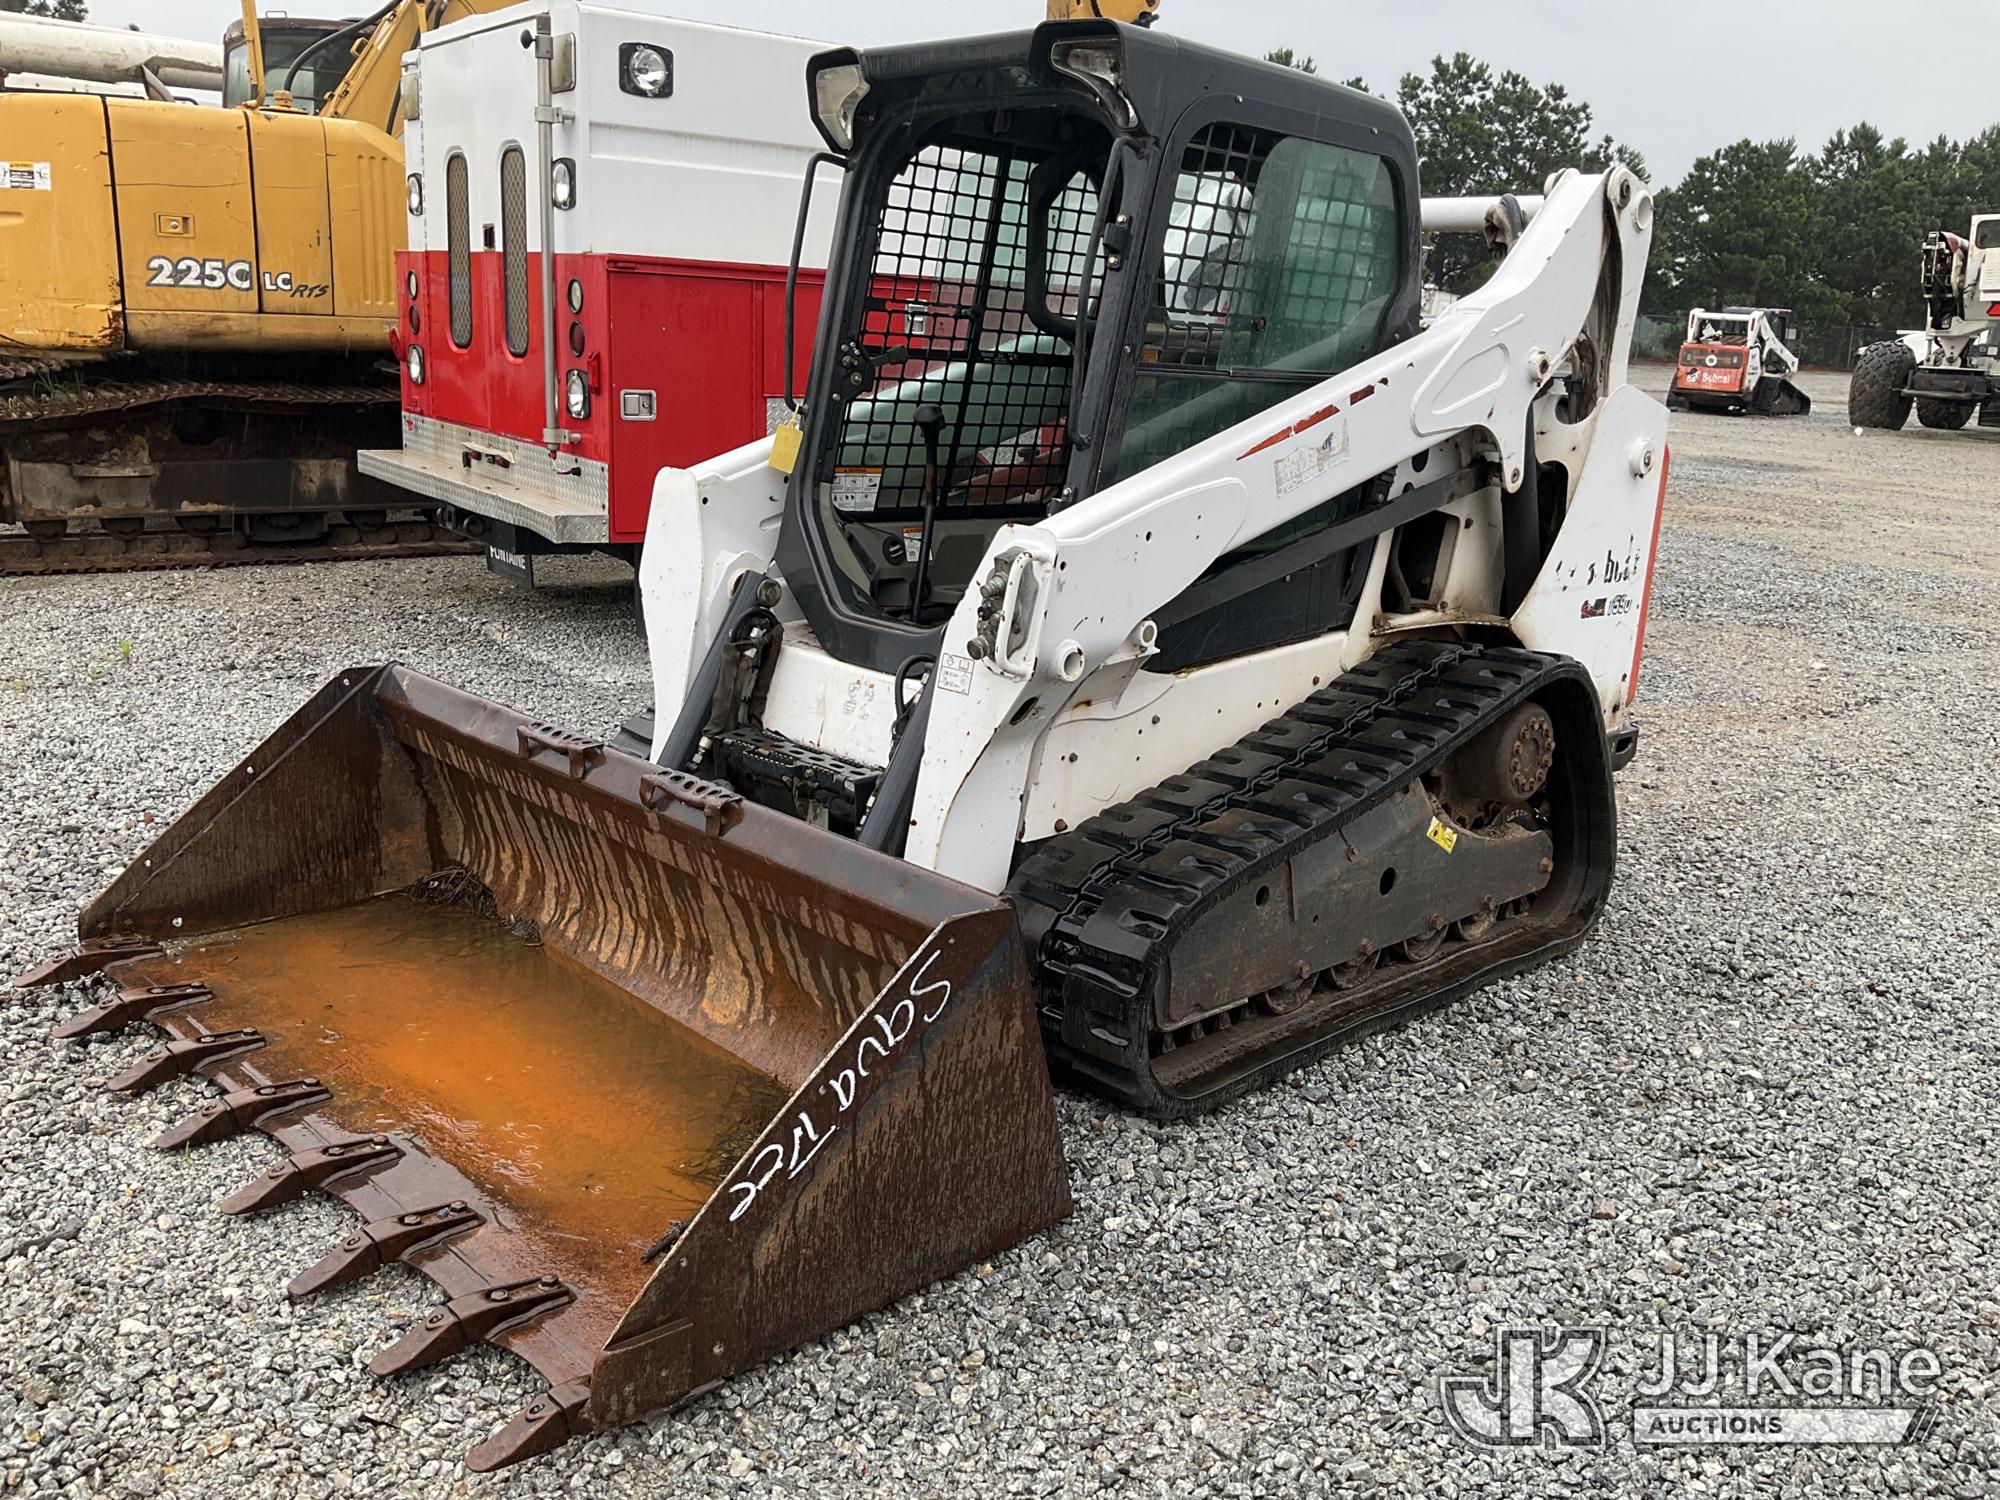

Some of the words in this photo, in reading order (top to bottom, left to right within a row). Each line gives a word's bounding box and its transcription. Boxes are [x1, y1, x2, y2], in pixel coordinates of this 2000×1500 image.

[146, 255, 253, 291] 225C
[263, 271, 292, 291] LC
[290, 284, 330, 298] RTS
